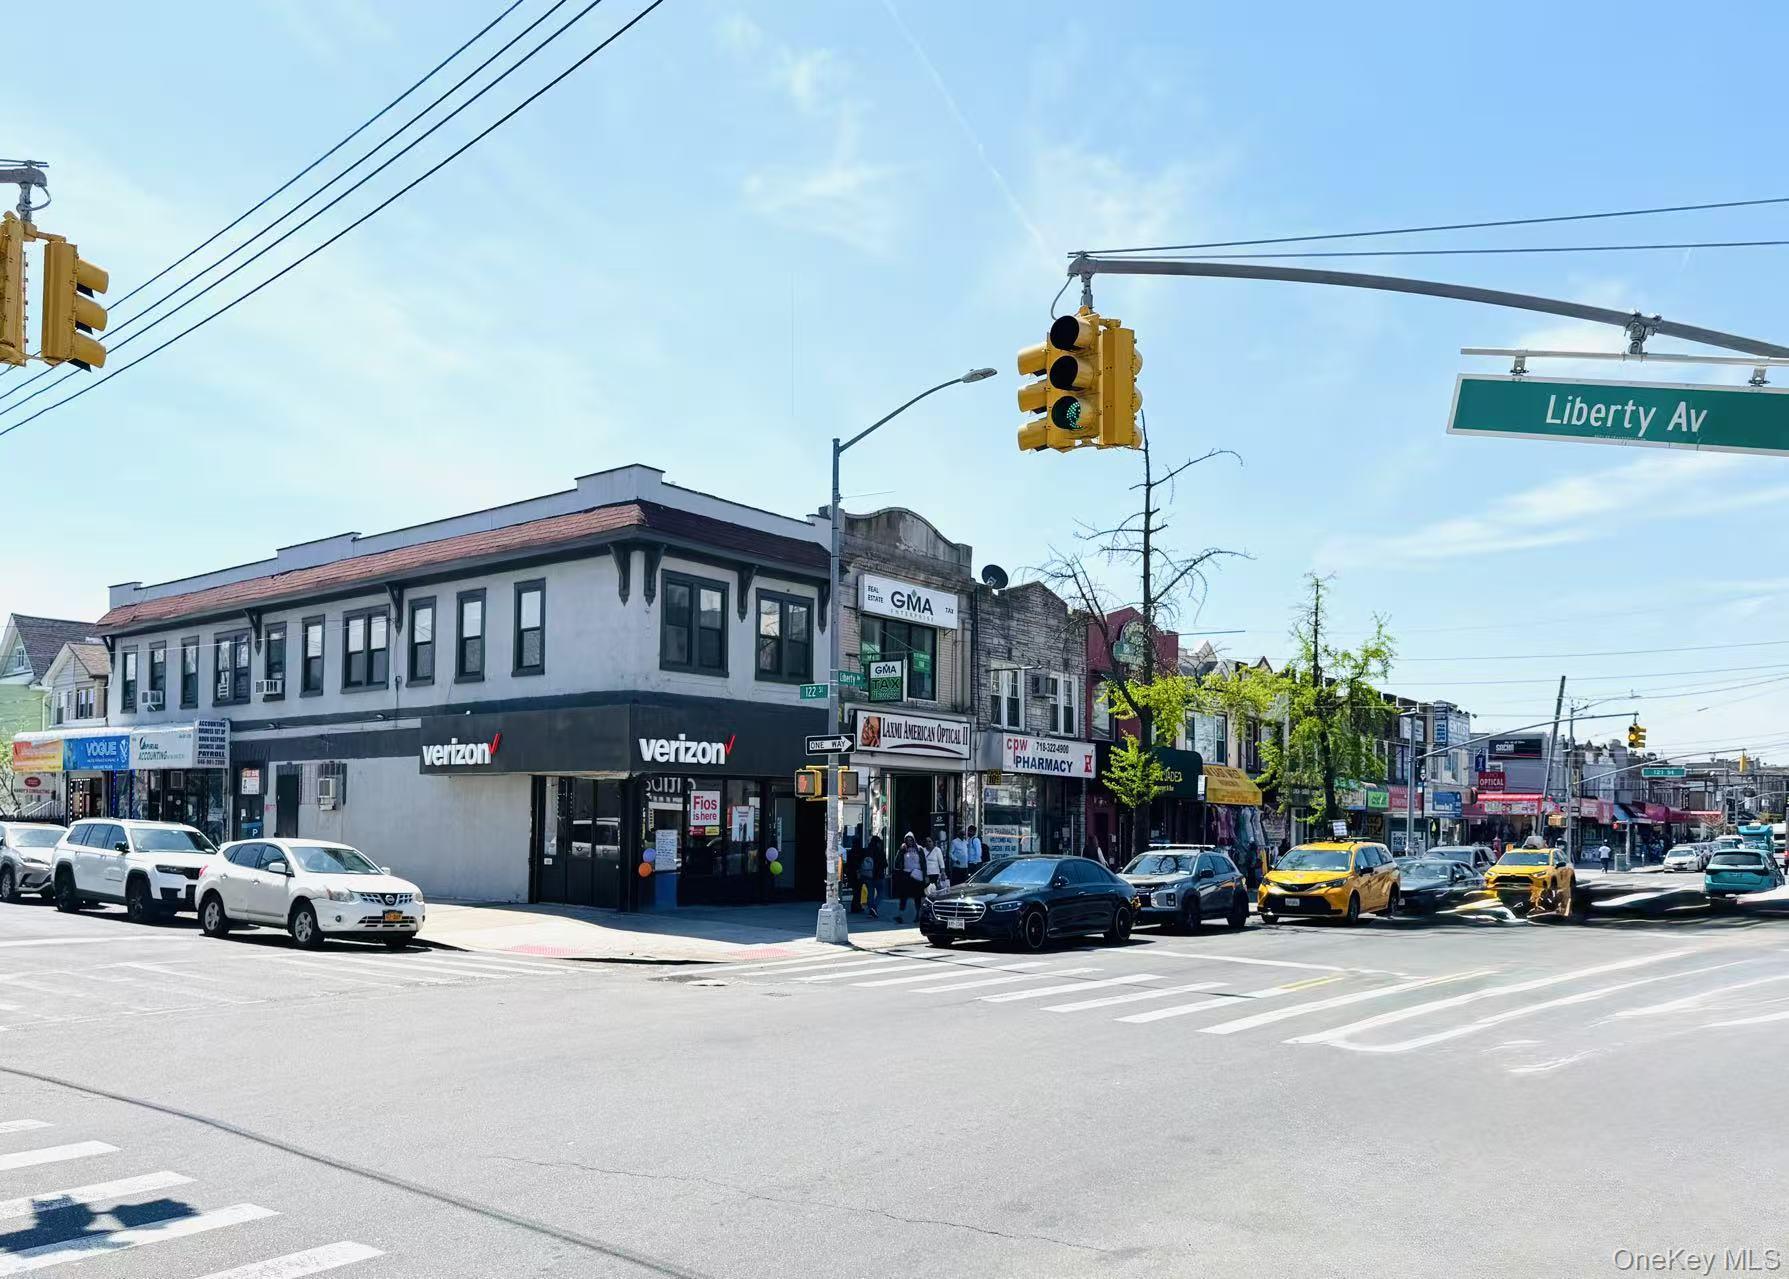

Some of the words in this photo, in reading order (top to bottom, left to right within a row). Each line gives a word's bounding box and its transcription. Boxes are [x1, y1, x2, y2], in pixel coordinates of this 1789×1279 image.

[1546, 394, 1657, 437] Liberty
[1667, 401, 1707, 433] Av
[867, 585, 879, 594] REAL
[867, 594, 884, 604] ESTATE
[890, 590, 934, 616] GMA
[875, 665, 897, 675] GMA
[840, 673, 856, 686] Liberty
[872, 679, 900, 690] TAX
[805, 687, 817, 697] 122
[199, 720, 226, 728] ACCOUNTING
[882, 717, 903, 738] LAXMI
[903, 720, 935, 742] AMERICAN
[936, 723, 961, 745] OPTICAL
[86, 740, 117, 757] VOGUE
[639, 733, 726, 765] verizon
[810, 741, 824, 749] ONE
[831, 740, 846, 748] WAY
[138, 750, 167, 760] ACCOUNTING
[198, 750, 225, 758] PAYROLL
[422, 737, 491, 766] verizon
[1015, 755, 1073, 773] PHARMACY
[1479, 778, 1504, 786] OPTICAL
[693, 795, 718, 811] Fios
[693, 811, 700, 821] is
[700, 811, 717, 821] here
[252, 828, 259, 837] P
